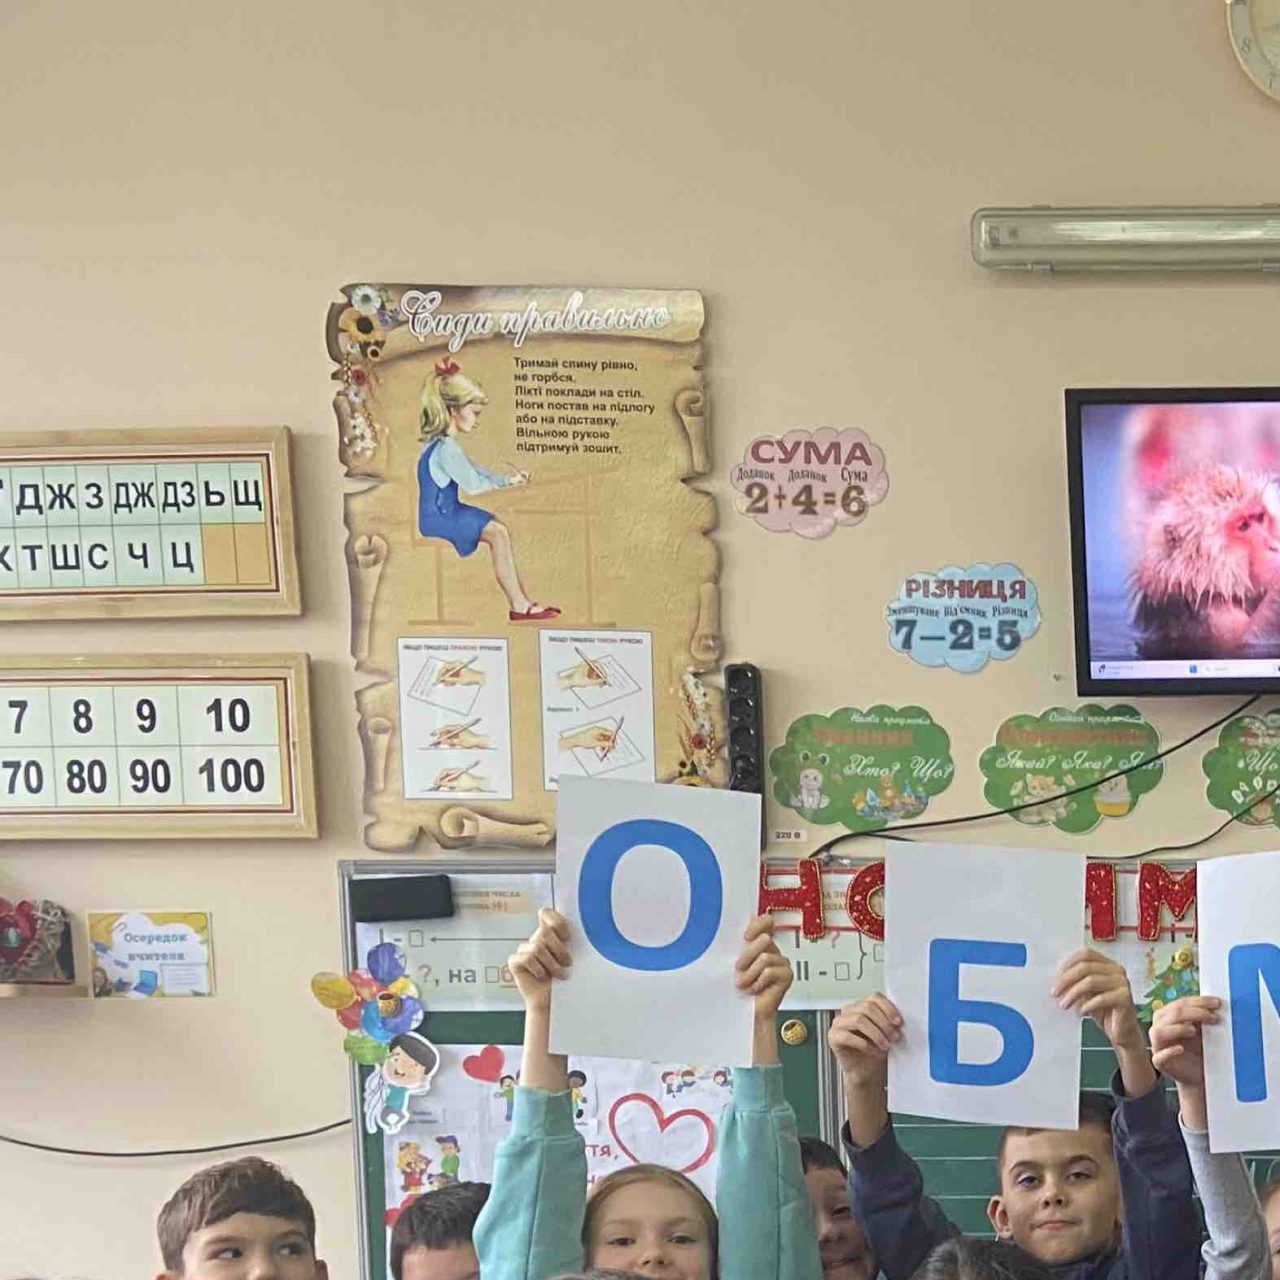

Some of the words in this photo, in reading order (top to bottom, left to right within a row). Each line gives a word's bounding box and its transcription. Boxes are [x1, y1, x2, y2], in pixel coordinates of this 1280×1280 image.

[401, 290, 492, 352] Сиди
[501, 291, 671, 348] правильно
[514, 357, 558, 370] Тримай
[562, 359, 598, 371] спину
[601, 360, 639, 372] рівно,
[514, 374, 529, 382] не
[515, 385, 542, 397] Лікті
[545, 387, 596, 398] поклади
[600, 389, 613, 398] на
[515, 400, 544, 411] Ноги
[547, 401, 589, 412] постав
[593, 402, 606, 412] на
[610, 403, 655, 416] підлогу
[516, 413, 538, 424] або
[541, 415, 555, 424] на
[516, 427, 569, 439] Вільною
[572, 430, 610, 441] рукою
[517, 442, 580, 454] підтримуй
[750, 439, 872, 467] СУМА
[737, 467, 775, 482] Доданок
[788, 468, 827, 483] Доданок
[840, 467, 868, 484] Сума
[16, 483, 43, 515] Д
[46, 483, 76, 510] Ж
[85, 482, 104, 509] З
[114, 482, 156, 515] ДЖ
[162, 481, 196, 513] ДЗ
[233, 480, 263, 511] Щ
[22, 544, 43, 570] Т
[52, 544, 80, 571] Ш
[87, 543, 108, 570] С
[128, 543, 148, 569] Ч
[171, 542, 194, 573] Ц
[906, 579, 1026, 602] РІЗНИЦЯ
[8, 700, 28, 734] 7
[73, 698, 93, 734] 8
[136, 698, 157, 734] 9
[206, 698, 251, 733] 10
[2, 760, 43, 794] 70
[66, 759, 107, 794] 80
[129, 759, 171, 793] 90
[199, 758, 265, 793] 100
[124, 932, 187, 945] Осередок
[128, 951, 185, 961] вчителя
[449, 969, 477, 984] на
